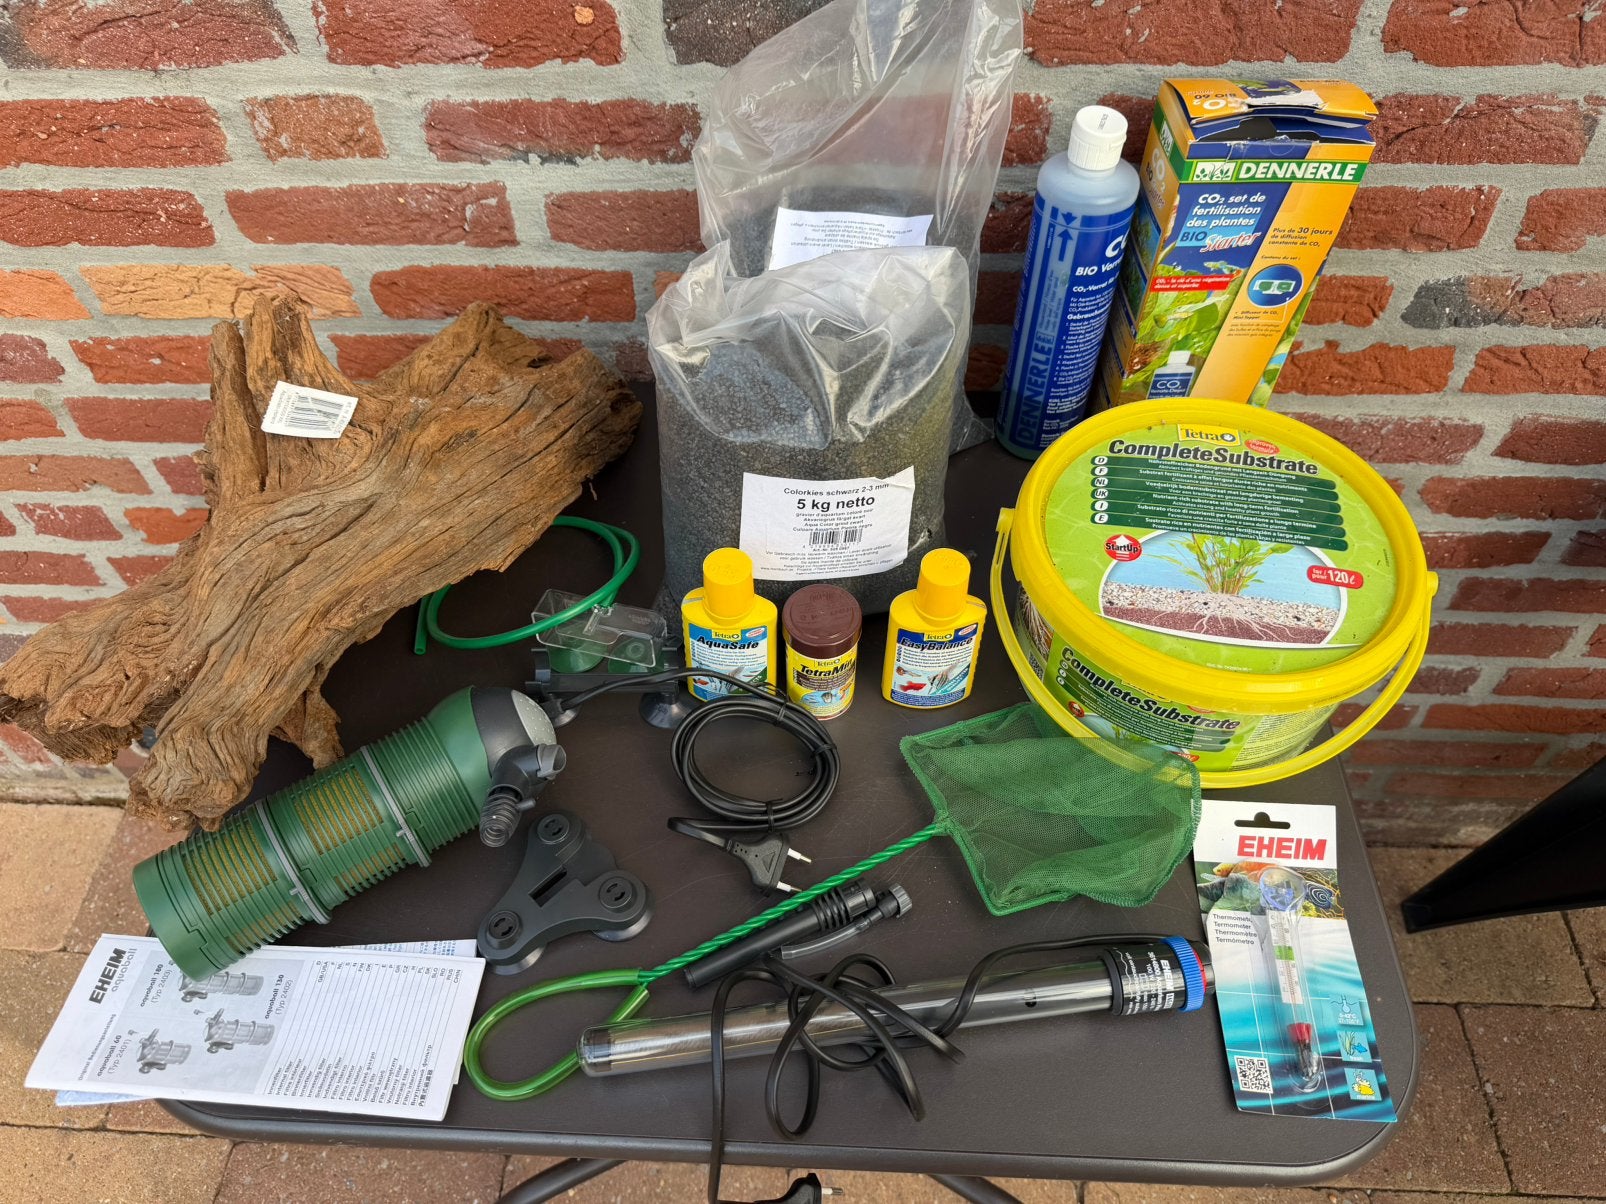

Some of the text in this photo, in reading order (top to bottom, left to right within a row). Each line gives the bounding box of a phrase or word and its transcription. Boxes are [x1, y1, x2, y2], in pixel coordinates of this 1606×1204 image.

[1239, 162, 1358, 180] DENNERLE
[1228, 194, 1248, 203] set
[1250, 192, 1266, 203] de
[1192, 204, 1261, 216] fertilisation
[1186, 216, 1255, 229] des plantes
[1180, 231, 1262, 253] BIO Starter
[1076, 266, 1098, 276] BIO
[1017, 342, 1052, 440] DENNERLE
[1183, 428, 1220, 441] Tetra
[1109, 440, 1318, 475] CompleteSubstrate
[1096, 478, 1107, 486] NL
[784, 488, 824, 496] Colorkies
[826, 488, 859, 496] schwarz
[797, 496, 875, 513] 5 kg netto
[1105, 541, 1138, 555] StartUp
[697, 636, 759, 650] AquaSafe
[901, 637, 973, 651] EasyBalance
[1061, 646, 1241, 730] CompleteSubstrate
[1237, 835, 1327, 860] EHEIM
[89, 948, 127, 1004] EHEIM
[111, 948, 138, 993] aquaball
[1160, 960, 1174, 990] EHEIM
[140, 963, 163, 1007] aquaball 180
[264, 988, 280, 1020] aquaball
[97, 1034, 122, 1077] aquaball 60
